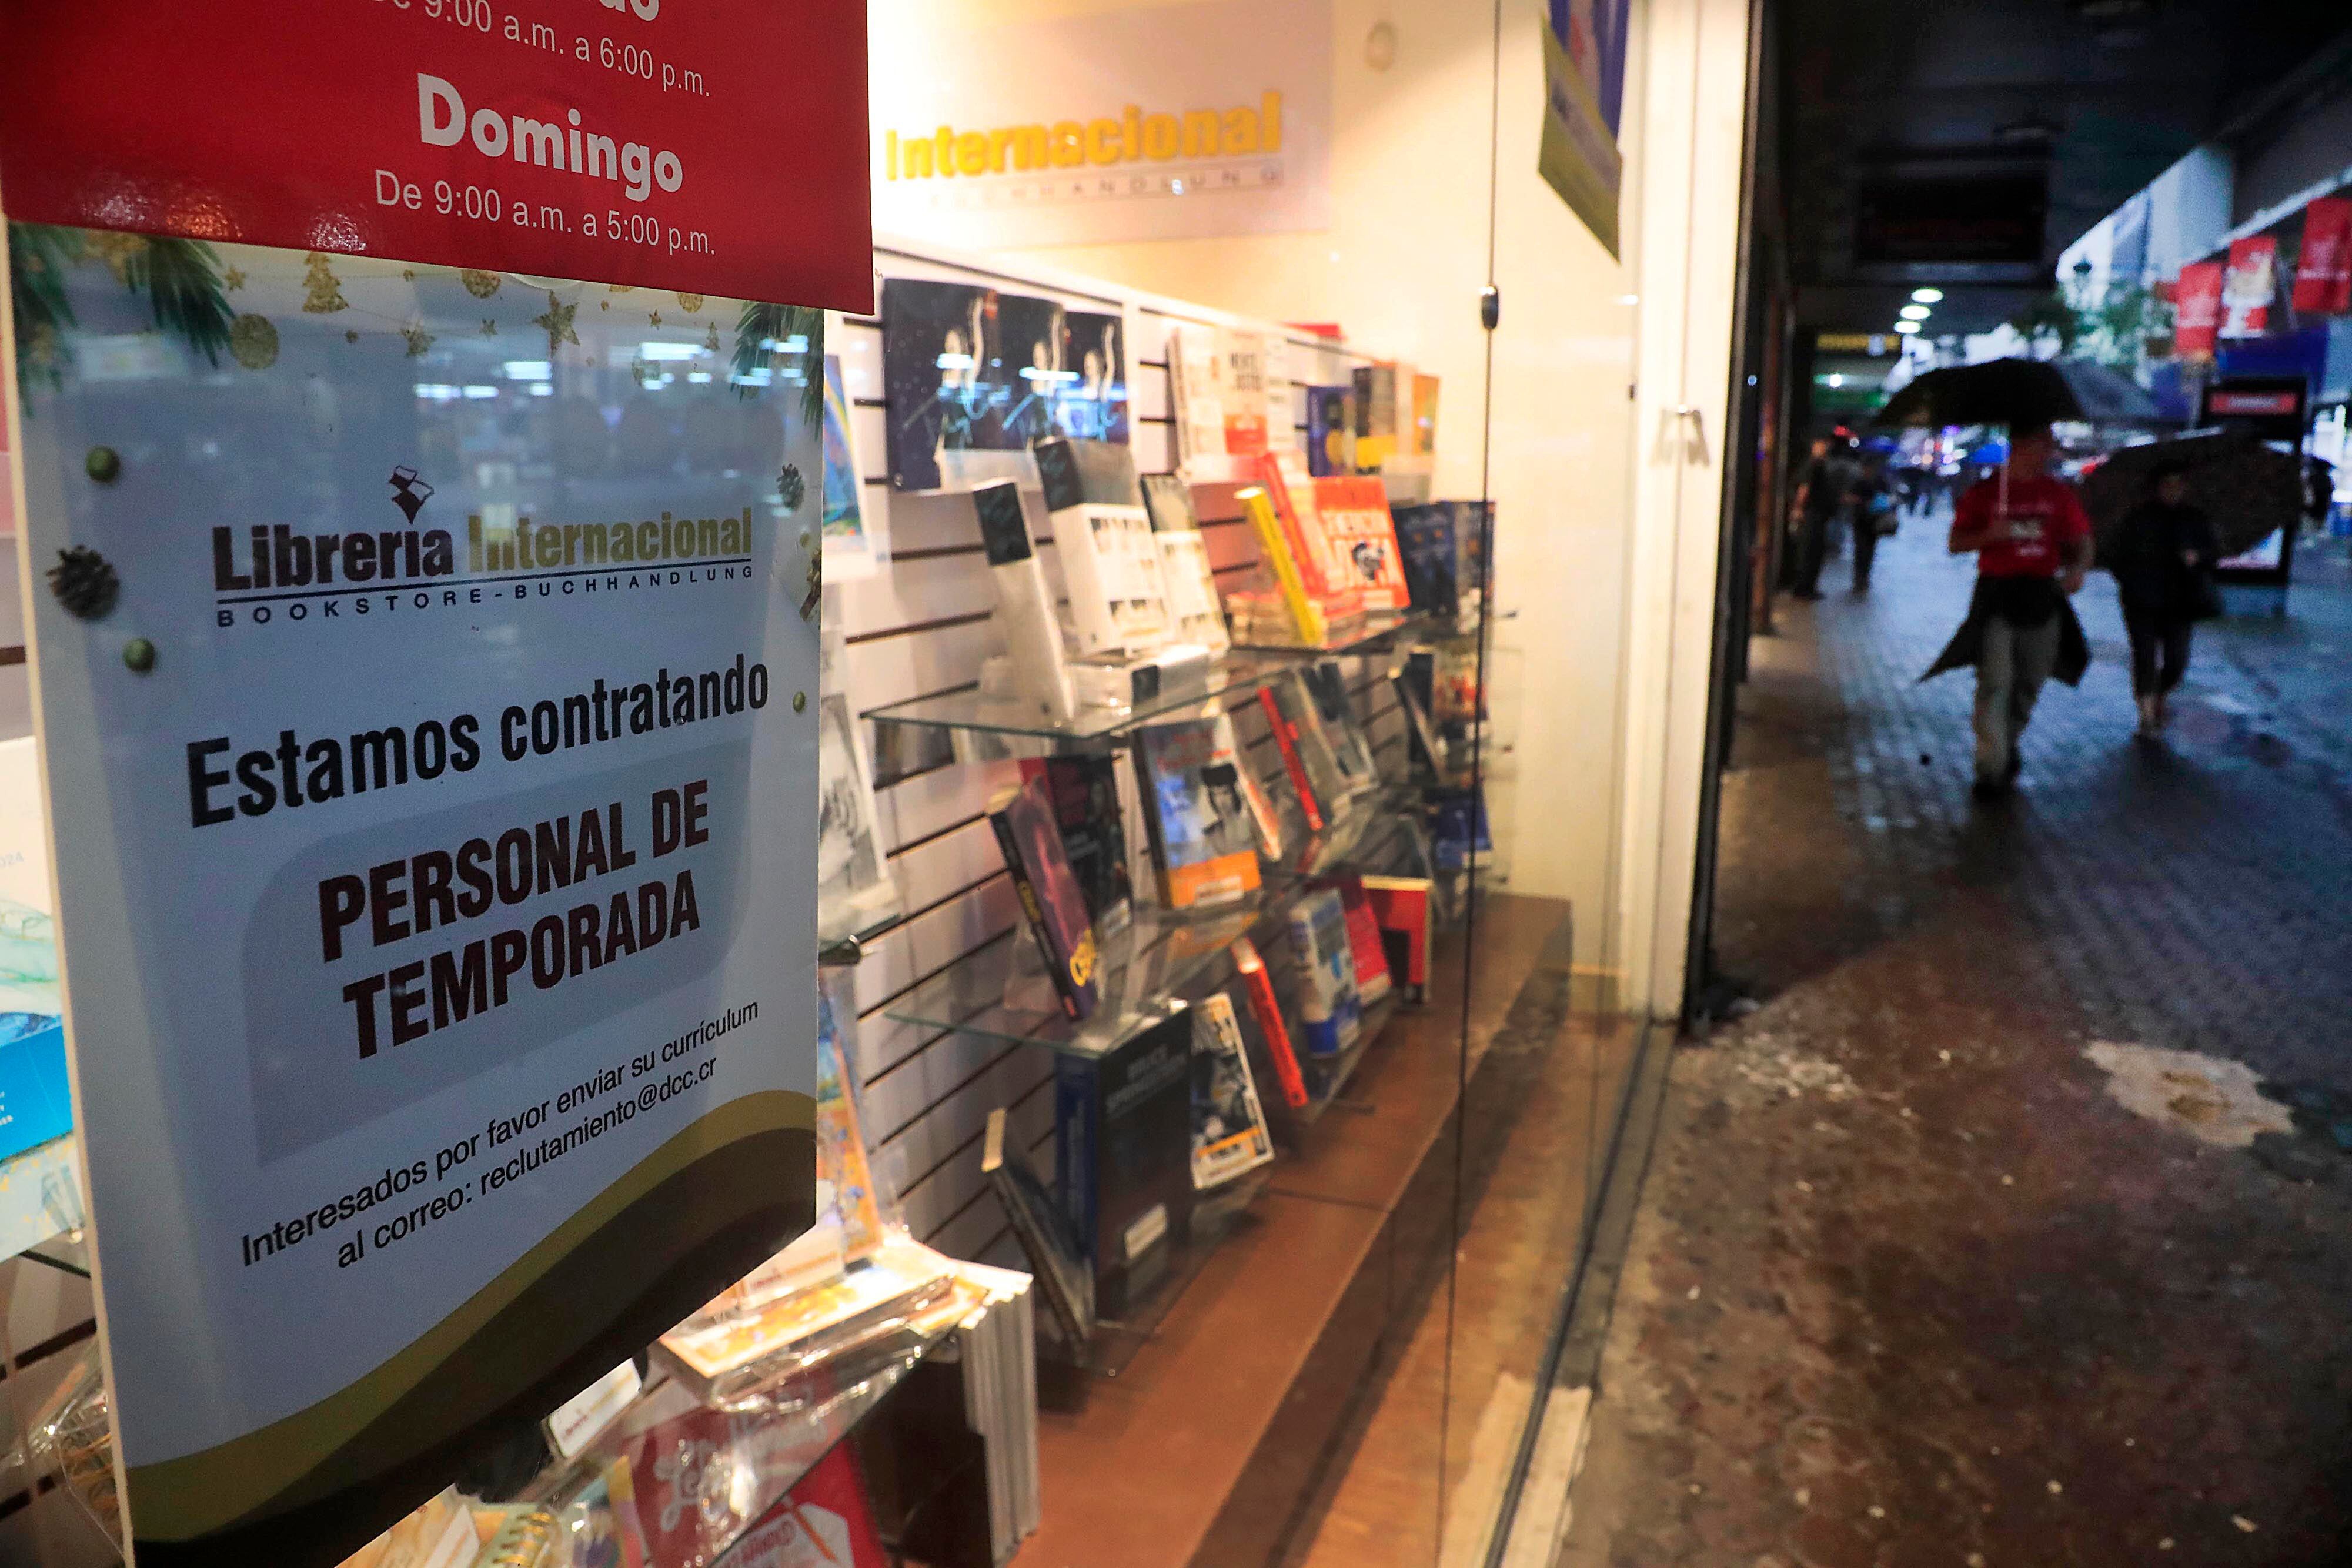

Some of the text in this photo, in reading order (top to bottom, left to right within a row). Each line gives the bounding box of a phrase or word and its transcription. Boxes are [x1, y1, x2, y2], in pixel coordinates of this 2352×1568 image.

[425, 0, 710, 97] 9:00 a.m. a 6:00 p.m.
[417, 72, 683, 202] Domingo
[885, 91, 1282, 181] Internacional
[375, 169, 715, 256] De 9:00 a.m. a 5:00 p.m.
[468, 507, 751, 573] Internacional
[187, 653, 768, 828] Estamos contratando
[318, 779, 709, 964] PERSONAL DE
[343, 869, 700, 1059] TEMPORADA
[242, 1001, 759, 1266] Interesados por favor enviar su currículum
[338, 1057, 717, 1268] al correo: reclutamiento@dcc.cr
